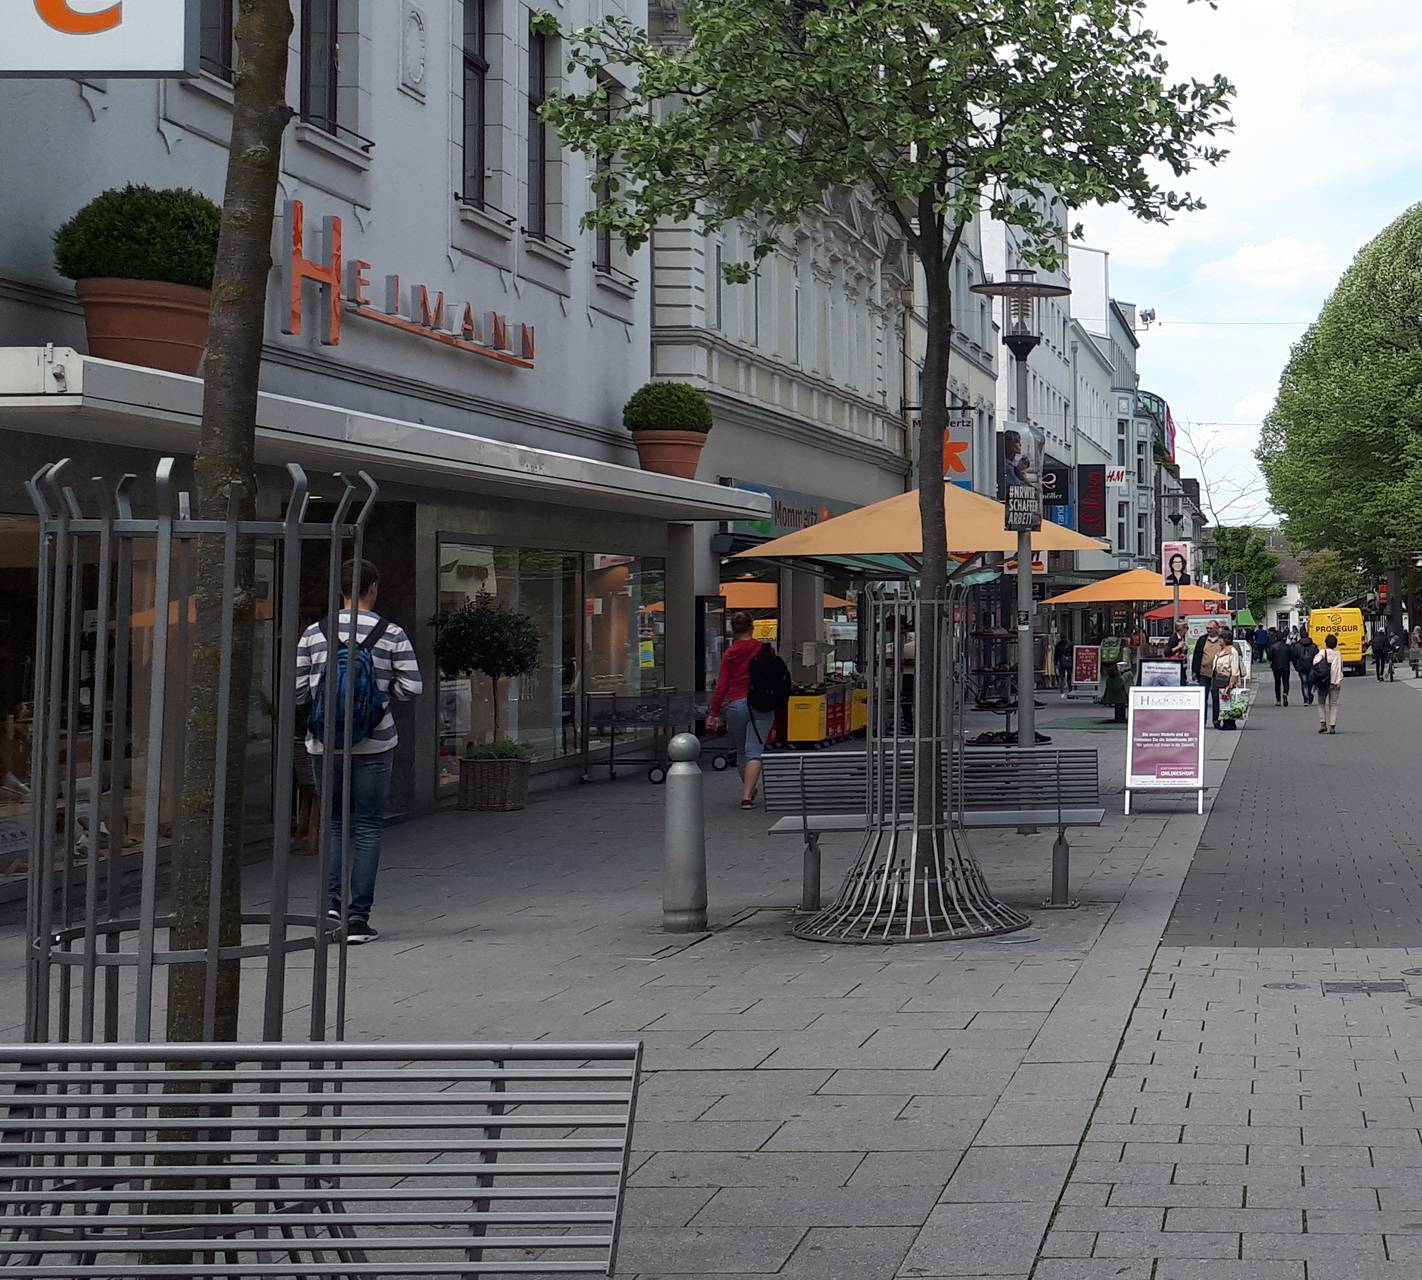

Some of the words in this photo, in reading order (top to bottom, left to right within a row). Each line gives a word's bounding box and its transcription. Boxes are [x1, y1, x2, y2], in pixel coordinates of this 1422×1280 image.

[281, 199, 535, 360] HEIMANN
[912, 420, 972, 428] Mertz
[1008, 511, 1032, 525] ARBEIT
[1315, 625, 1359, 633] PROSEGUR
